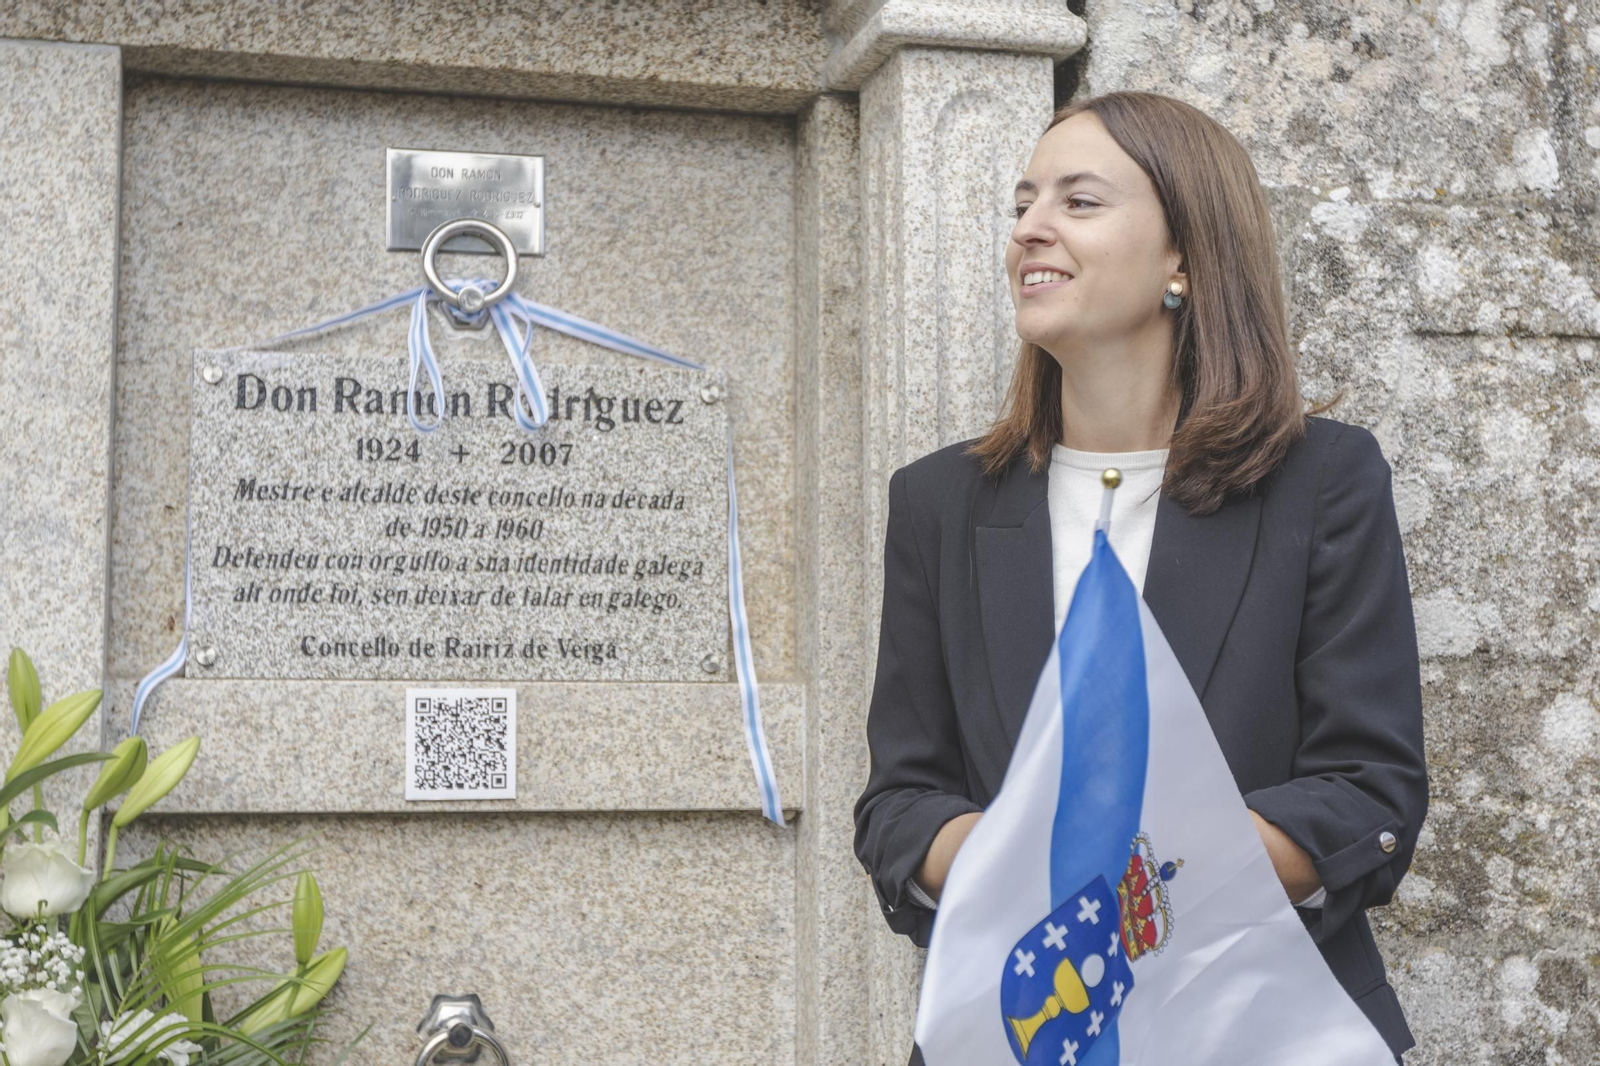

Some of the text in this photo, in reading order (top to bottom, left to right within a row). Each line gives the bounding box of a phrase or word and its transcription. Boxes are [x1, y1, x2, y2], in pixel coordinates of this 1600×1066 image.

[431, 166, 454, 179] DON
[235, 373, 318, 412] Don
[356, 437, 421, 463] 1924
[501, 441, 573, 467] 2007
[234, 477, 315, 502] Mestre
[321, 485, 334, 502] e
[339, 478, 421, 505] alcalde
[424, 482, 483, 506] deste
[488, 485, 579, 510] concello
[582, 491, 608, 510] na
[386, 516, 544, 541] de 1950 a 1960
[212, 545, 318, 571] Defendeu
[325, 553, 363, 571] con
[369, 551, 450, 577] orgullo
[455, 557, 468, 573] a
[515, 552, 630, 577] identidade
[633, 554, 705, 583] galega
[269, 583, 323, 604] onde
[371, 589, 408, 605] sen
[414, 584, 486, 608] deixar
[491, 584, 516, 607] de
[521, 585, 574, 608] falar
[579, 593, 604, 608] en
[301, 635, 618, 665] Concello de Rairiz de Veiga
